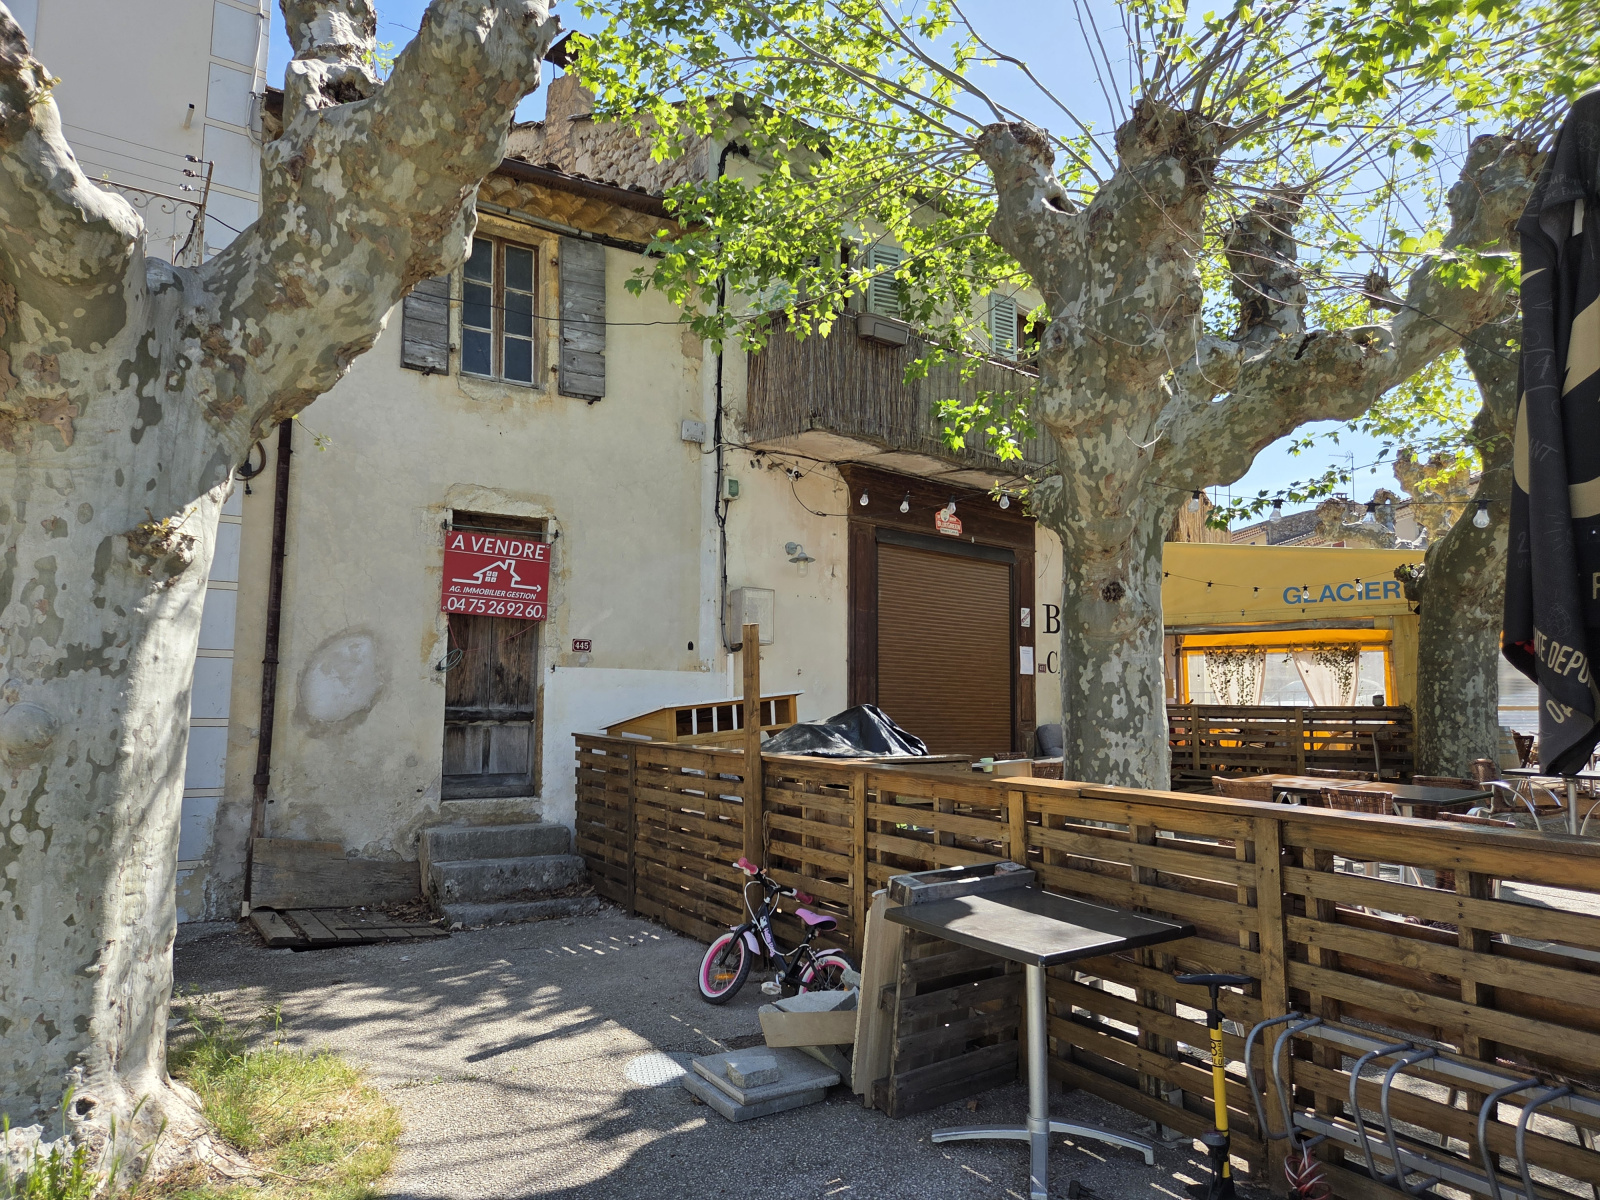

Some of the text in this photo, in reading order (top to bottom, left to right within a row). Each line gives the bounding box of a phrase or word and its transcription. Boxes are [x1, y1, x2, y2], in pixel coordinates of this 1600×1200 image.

[451, 534, 546, 560] A VENDRE
[463, 586, 506, 598] IMMOBILIER
[506, 590, 537, 600] GESTION
[447, 597, 542, 619] 04 75 26 92 60
[574, 641, 589, 650] 445
